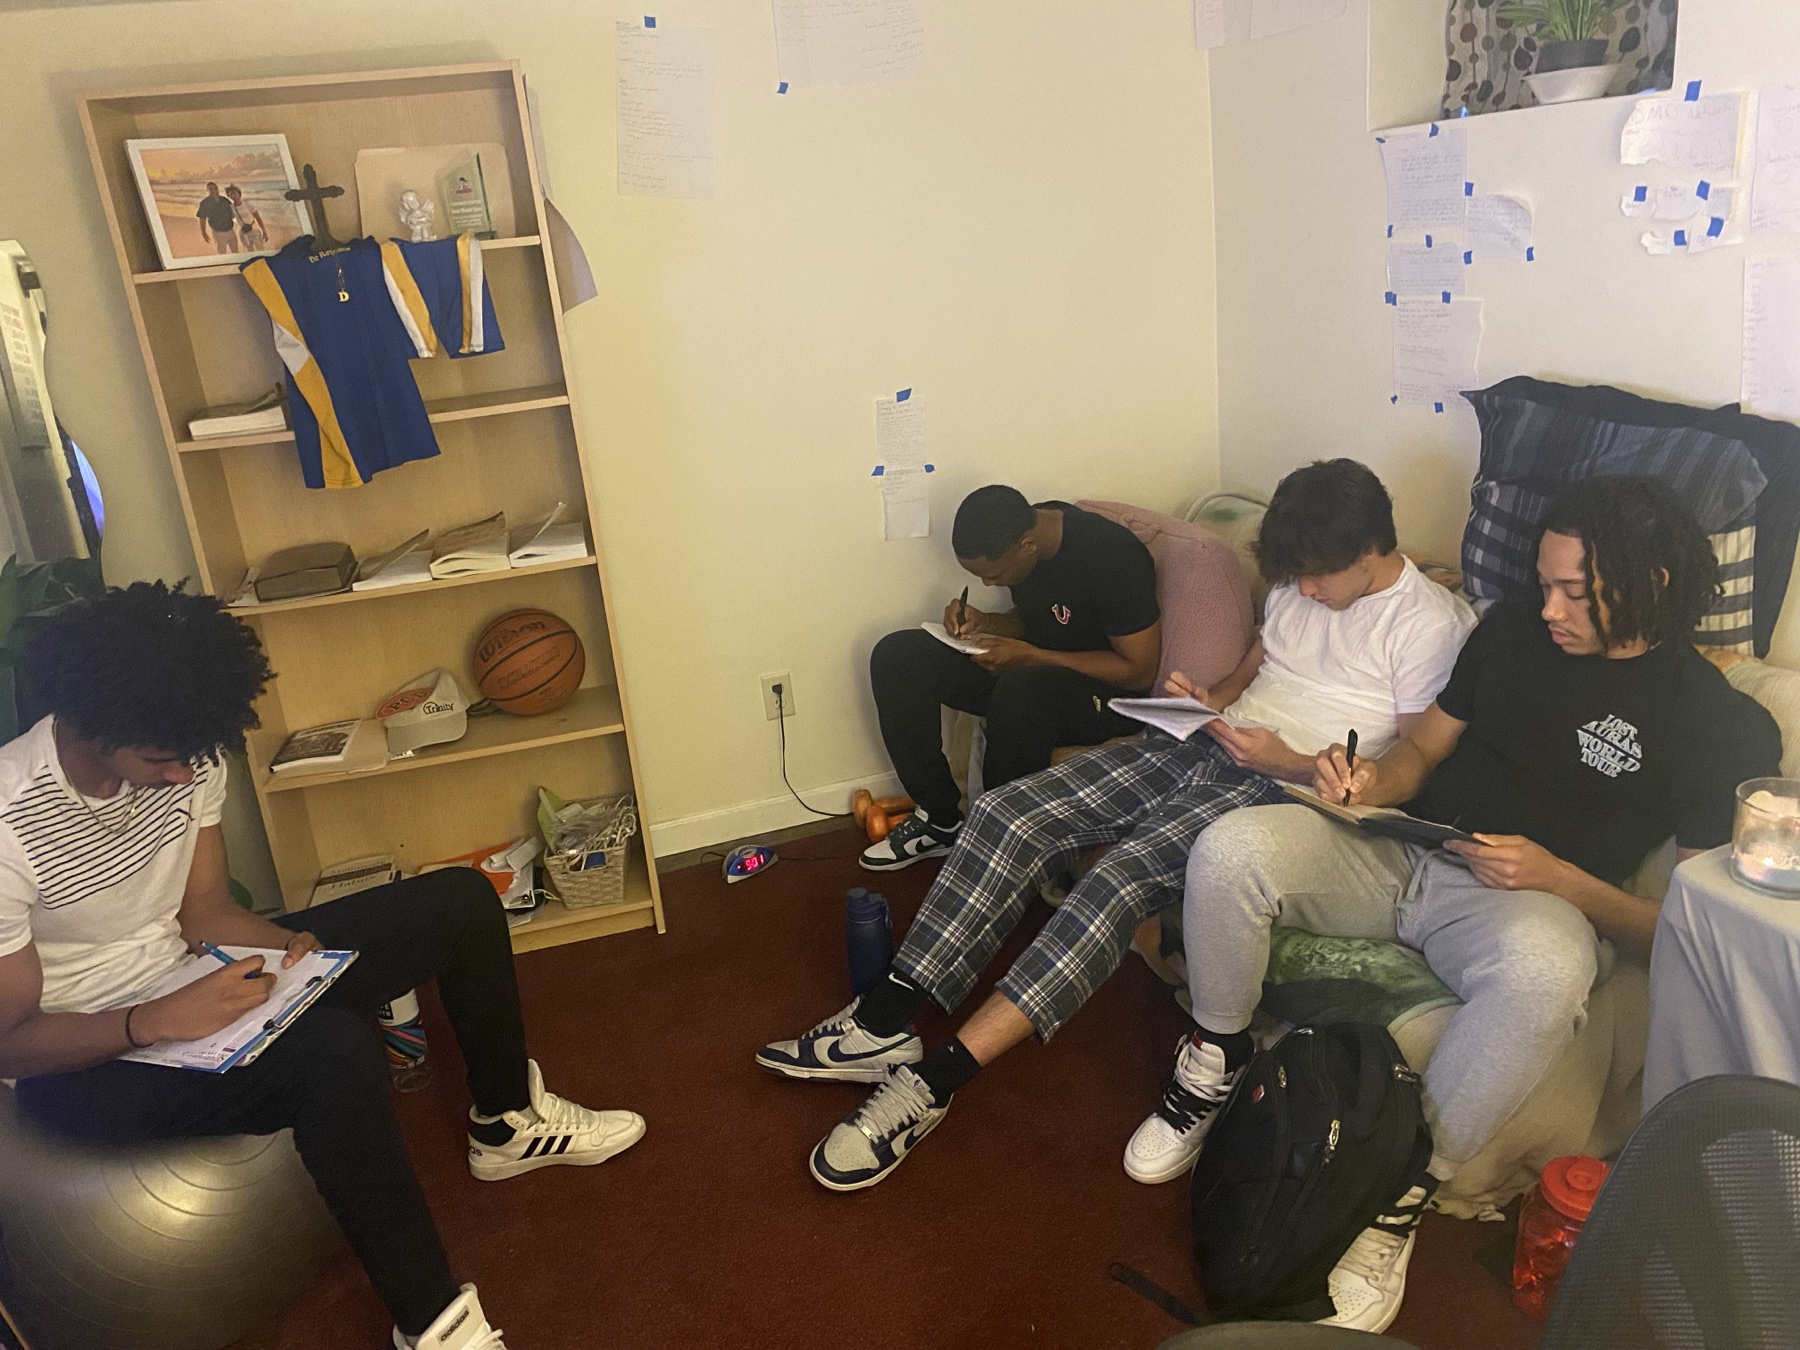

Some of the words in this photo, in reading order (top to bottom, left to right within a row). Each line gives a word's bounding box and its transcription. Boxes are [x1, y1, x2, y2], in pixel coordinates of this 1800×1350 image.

[338, 291, 350, 302] D
[480, 621, 546, 662] Wilson
[423, 701, 454, 715] Trinity
[1582, 720, 1643, 759] AURAS
[1600, 714, 1638, 741] LOST
[1576, 729, 1641, 772] WORLD
[1580, 747, 1622, 778] TOUR
[440, 1310, 470, 1341] adidas
